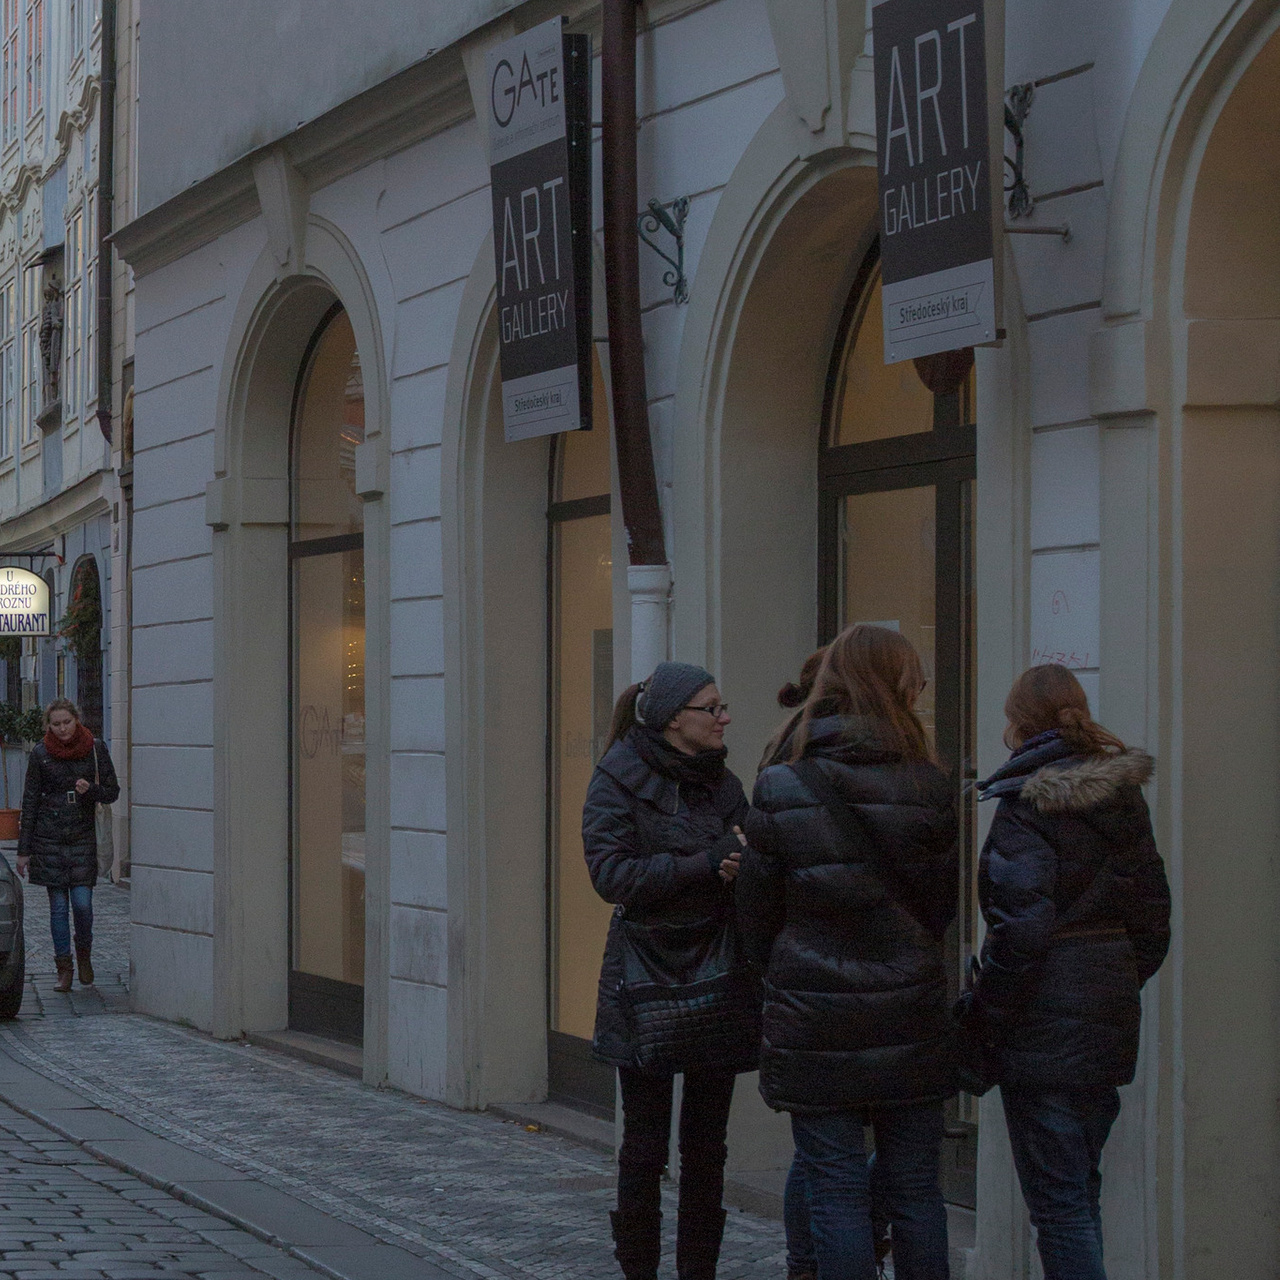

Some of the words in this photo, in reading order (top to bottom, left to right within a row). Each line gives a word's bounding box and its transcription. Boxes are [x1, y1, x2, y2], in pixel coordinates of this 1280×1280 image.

[883, 12, 977, 176] ART
[884, 160, 982, 237] GALLERY
[501, 176, 564, 297] ART
[501, 289, 569, 345] GALLERY
[899, 295, 951, 324] Středočeský
[951, 291, 970, 315] kraj
[514, 391, 549, 413] Středočeský
[549, 388, 563, 407] kraj
[5, 570, 14, 583] U
